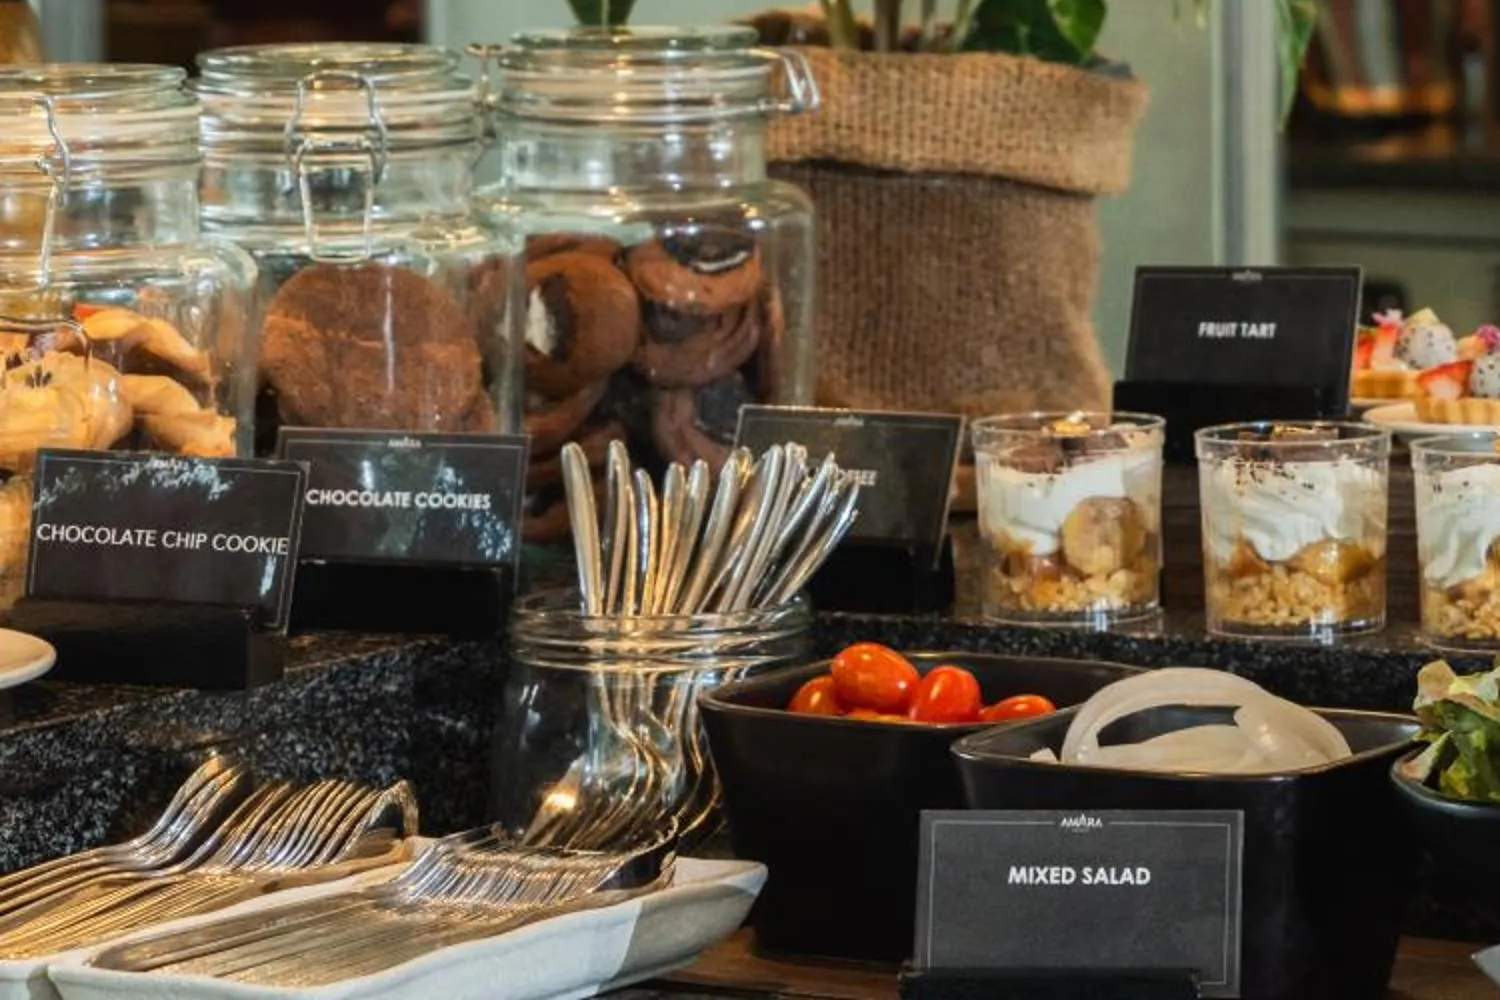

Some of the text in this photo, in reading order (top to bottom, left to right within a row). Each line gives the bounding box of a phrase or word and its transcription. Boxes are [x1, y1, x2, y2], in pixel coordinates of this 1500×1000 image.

[1198, 321, 1277, 339] FRUIT TART
[305, 488, 491, 511] CHOCOLATE COOKIES
[37, 523, 289, 555] CHOCOLATE CHIP COOKIE
[1008, 866, 1151, 886] MIXED SALAD
